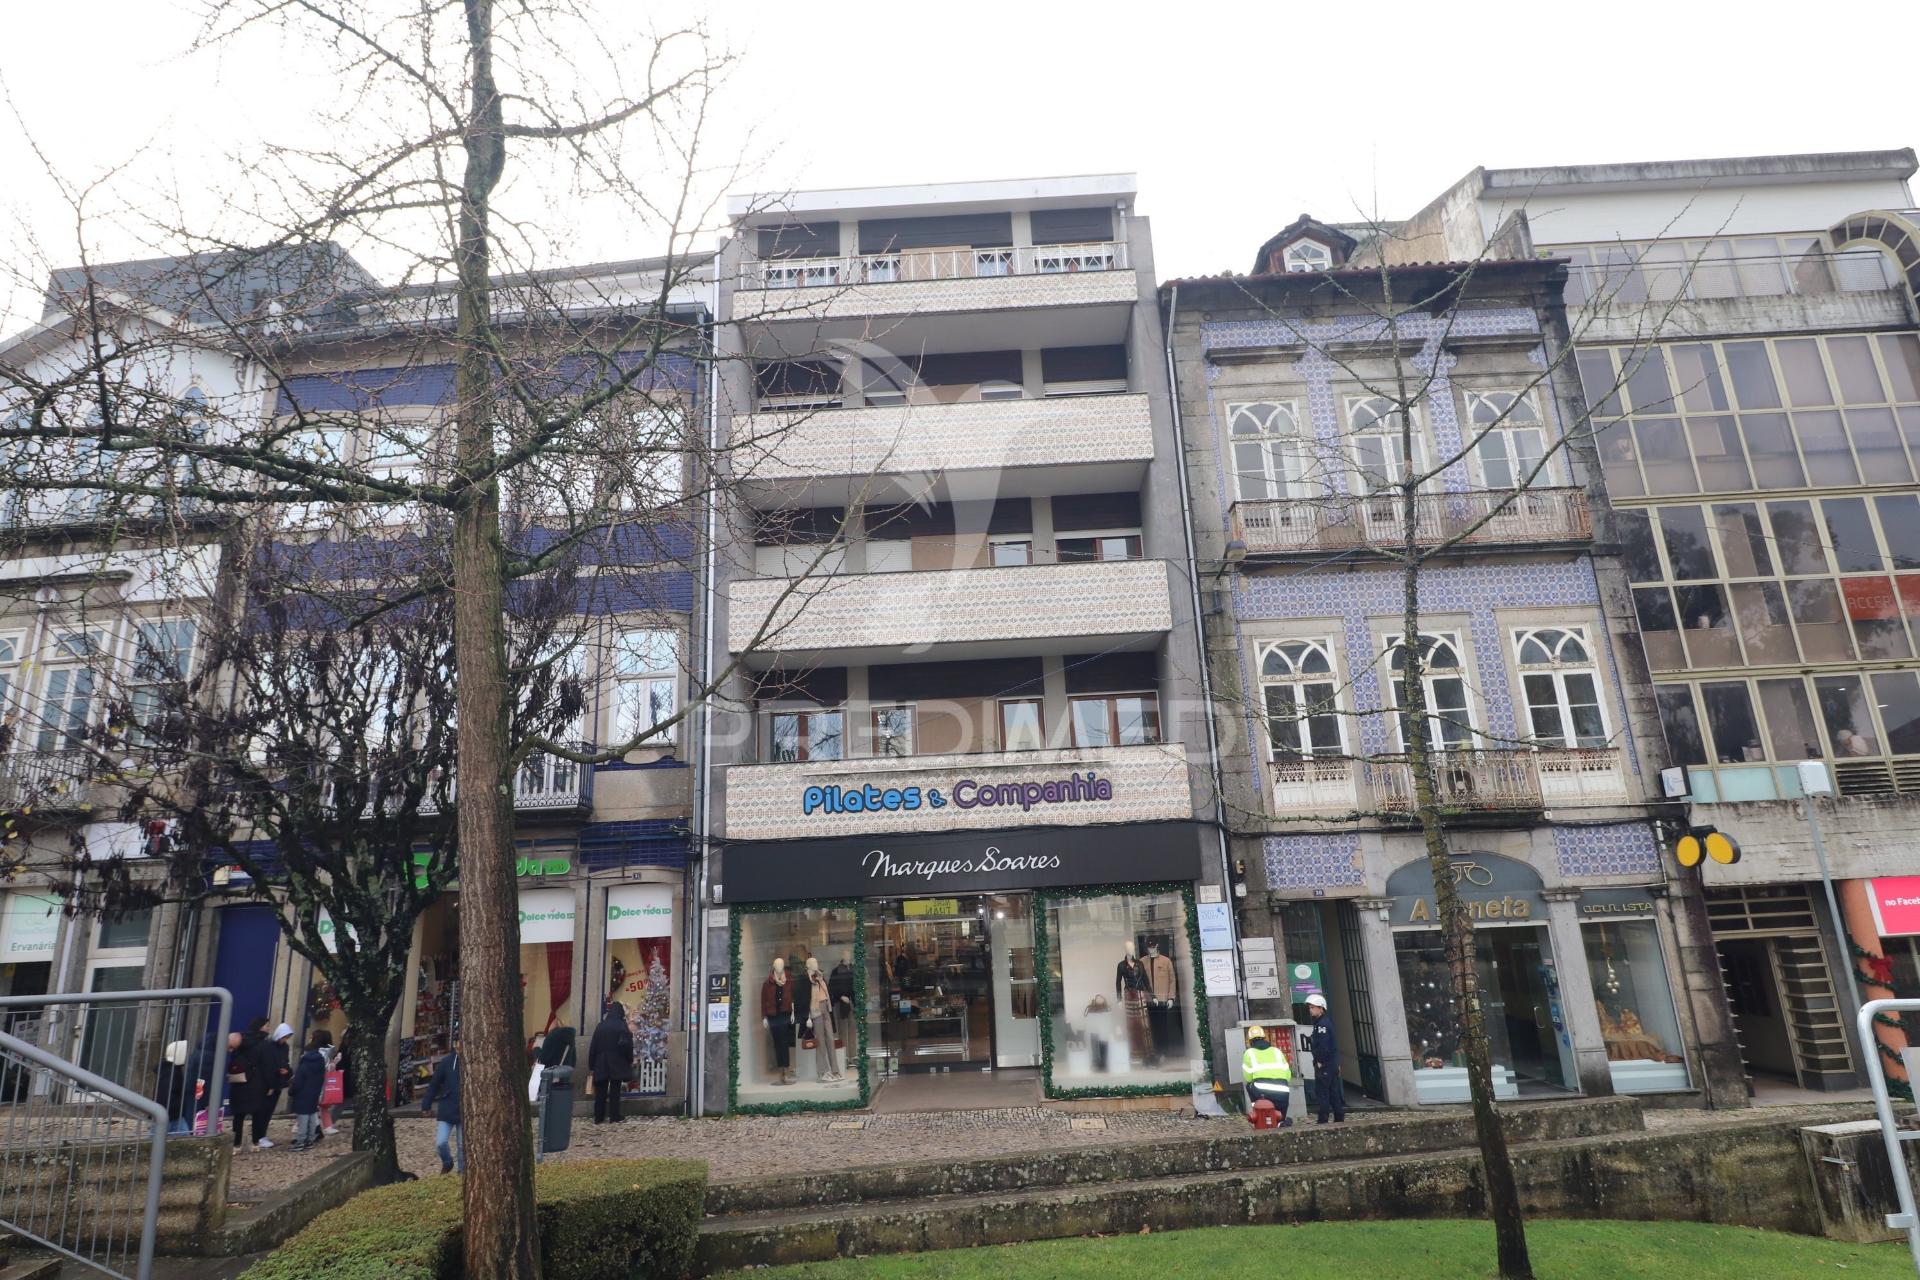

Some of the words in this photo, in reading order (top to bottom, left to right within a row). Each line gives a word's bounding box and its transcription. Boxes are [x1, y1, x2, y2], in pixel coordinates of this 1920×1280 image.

[803, 783, 922, 815] Pilates
[927, 788, 948, 808] &
[952, 772, 1113, 812] Companhia
[862, 850, 972, 880] Marques
[974, 846, 1060, 872] Soares
[547, 909, 566, 920] vida
[608, 905, 641, 921] Dolce
[642, 905, 662, 916] vida
[11, 941, 57, 951] Ervanária
[1266, 987, 1278, 996] 36
